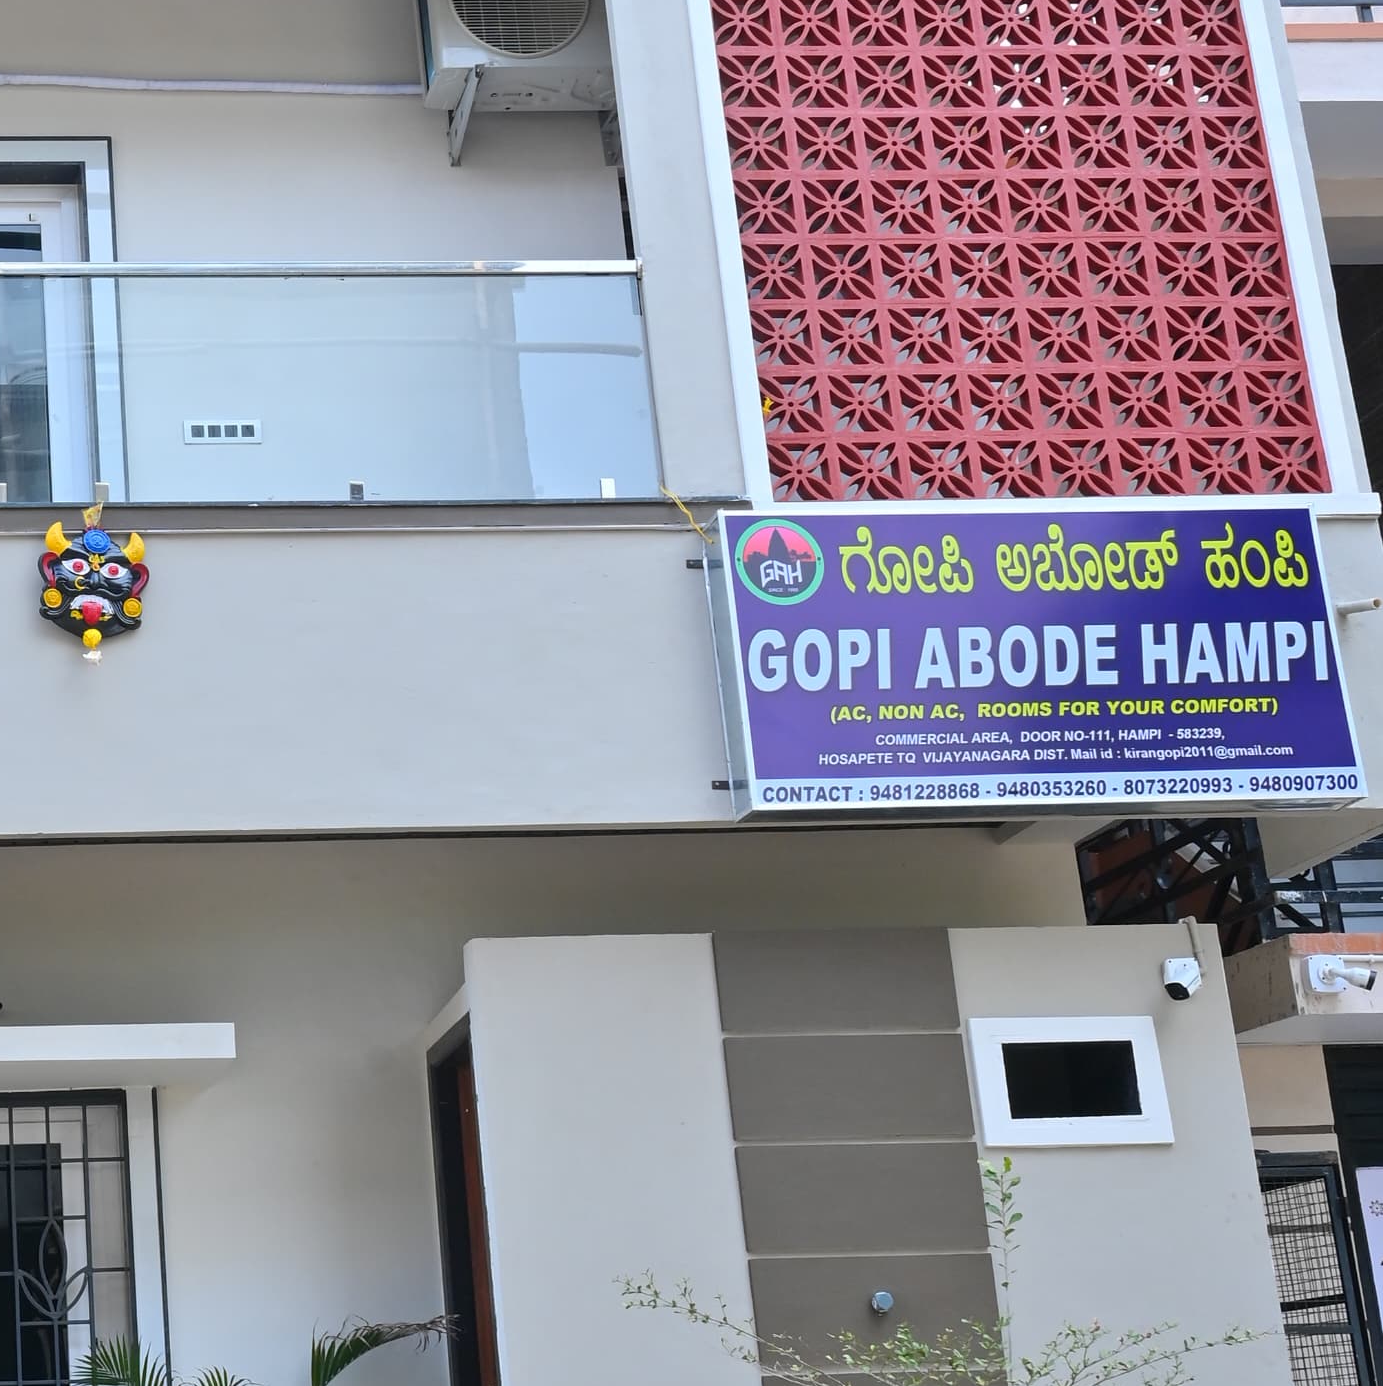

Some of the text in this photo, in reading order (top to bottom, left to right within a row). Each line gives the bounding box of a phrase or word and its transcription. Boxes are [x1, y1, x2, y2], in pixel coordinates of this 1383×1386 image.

[838, 521, 1310, 594] ಗೋಪಿ ಅಬೋಡ್ ಹಂಪಿ
[759, 559, 803, 588] GAH
[748, 620, 1330, 693] GOPI ABODE HAMPI
[830, 697, 1278, 724] (AC, NON AC, ROOMS FOR YOUR COMFORT)
[875, 732, 968, 746] COMMERCIAL
[971, 731, 1013, 744] AREA,
[1020, 730, 1061, 743] DOOR
[1064, 729, 1114, 743] NO-111,
[1118, 728, 1162, 741] HAMPI
[1176, 727, 1225, 741] 583239,
[818, 753, 893, 766] HOSAPETE
[897, 752, 916, 764] TQ
[923, 749, 1030, 763] VIJAYANAGARA
[1034, 748, 1068, 761] DIST.
[1071, 747, 1097, 760] Mail
[1100, 747, 1113, 759] id
[1124, 744, 1294, 761] kirangopi2011@gmail.com
[762, 785, 853, 803] CONTACT
[870, 783, 980, 801] 9481228868
[996, 780, 1107, 798] 9480353260
[1123, 776, 1233, 795] 8073220993
[1249, 773, 1359, 792] 9480907300
